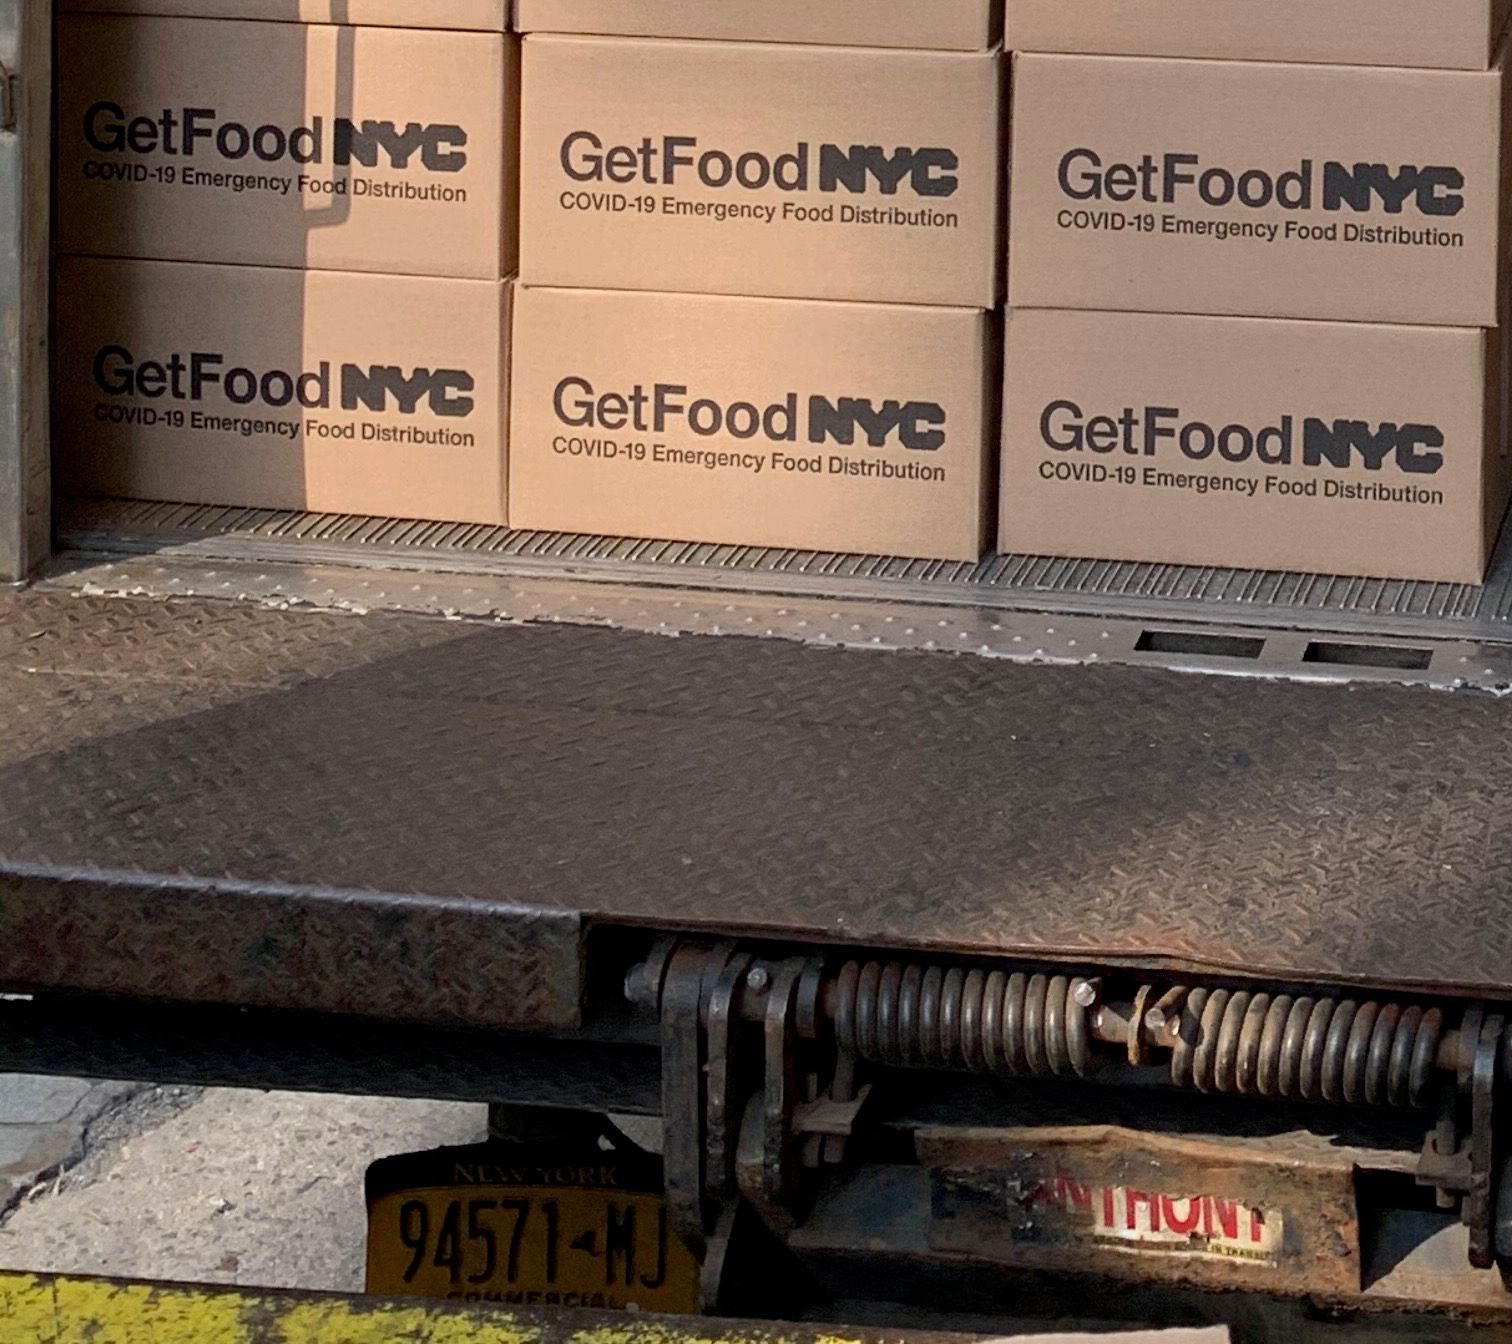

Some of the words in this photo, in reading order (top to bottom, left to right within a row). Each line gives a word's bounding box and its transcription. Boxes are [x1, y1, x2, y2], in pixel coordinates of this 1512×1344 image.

[84, 160, 176, 184] COVID-19
[182, 166, 292, 195] Emergency
[298, 174, 347, 195] Food
[353, 178, 466, 202] Distribution
[552, 436, 646, 461] COVID-19
[653, 443, 766, 473] Emergency
[771, 452, 822, 473] Food
[829, 456, 945, 481] Distribution
[1039, 460, 1136, 485] COVID-19
[1143, 467, 1259, 497] Emergency
[1265, 475, 1317, 497] Food
[1324, 479, 1443, 505] Distribution
